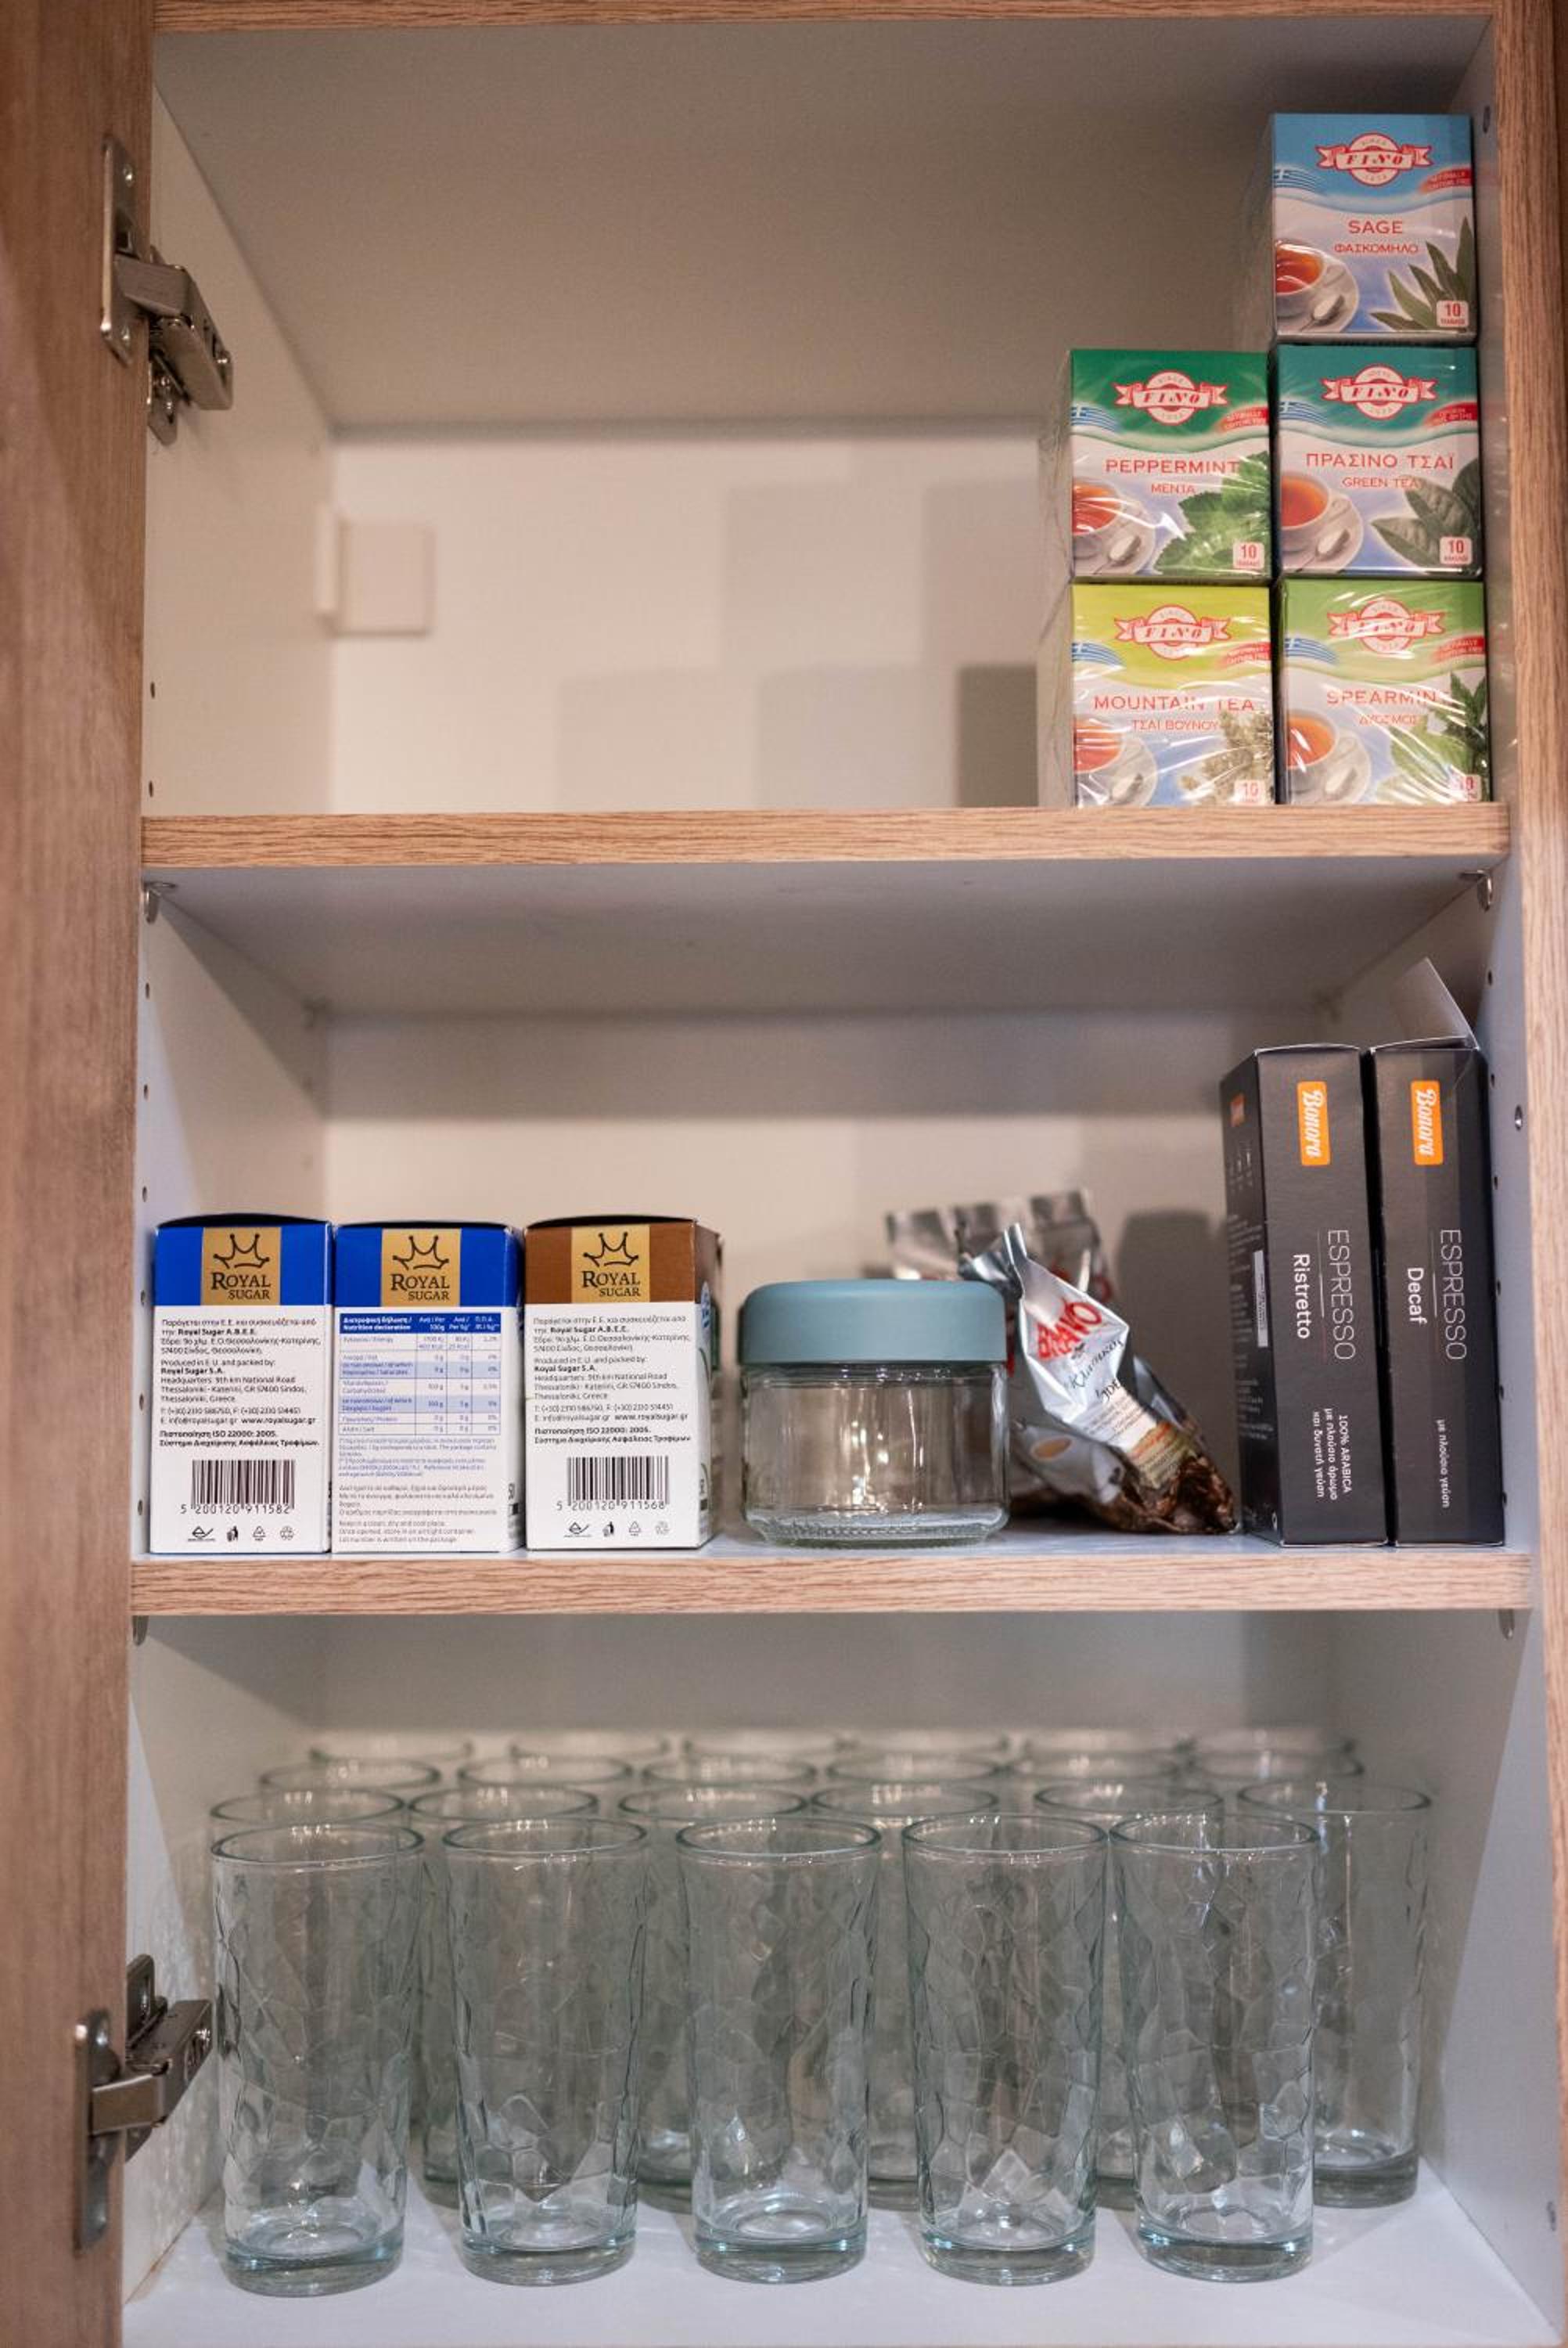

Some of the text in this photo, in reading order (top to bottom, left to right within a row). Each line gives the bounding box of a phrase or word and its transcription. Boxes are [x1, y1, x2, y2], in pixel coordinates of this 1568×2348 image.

[1346, 154, 1404, 165] FINO
[1348, 220, 1403, 234] SAGE
[1444, 303, 1461, 316] 10
[1140, 393, 1200, 404] FINO
[1351, 388, 1409, 398] FINO
[1105, 459, 1240, 474] PEPPERMINT
[1306, 453, 1397, 468] ΠΡΑΣΙΝΟ
[1342, 477, 1418, 488] GREEN TEA
[1240, 544, 1257, 559] 10
[1448, 540, 1463, 554] 10
[1145, 628, 1203, 639] FINO
[1216, 698, 1254, 711] TEA
[1301, 1090, 1325, 1158] Bonora
[1415, 1089, 1438, 1157] Bonora
[211, 1273, 271, 1290] ROYAL
[390, 1274, 450, 1291] ROYAL
[582, 1270, 640, 1288] ROYAL
[228, 1290, 270, 1300] SUGAR
[408, 1291, 450, 1301] SUGAR
[599, 1287, 640, 1297] SUGAR
[1293, 1255, 1312, 1339] Ristretto
[1328, 1230, 1356, 1360] ESPRESSO
[1407, 1267, 1427, 1325] Decaf
[1440, 1229, 1467, 1360] ESPRESSO
[178, 1328, 201, 1337] Royal
[202, 1328, 225, 1337] Sugar
[550, 1326, 573, 1335] Royal
[574, 1326, 596, 1335] Sugar
[237, 1359, 264, 1368] packed
[608, 1356, 636, 1365] packed
[160, 1367, 184, 1376] Royal
[185, 1367, 208, 1376] Sugar
[534, 1365, 556, 1374] Royal
[557, 1365, 580, 1374] Sugar
[209, 1395, 236, 1403] Greece
[614, 1413, 689, 1423] www.royalsugar.gr
[1323, 1408, 1334, 1421] με
[241, 1417, 316, 1425] www.royalsugar.gr
[1436, 1419, 1446, 1431] με
[1338, 1414, 1352, 1493] 100% ARABICA
[1440, 1477, 1451, 1508] γεύση
[180, 1504, 290, 1514] 5 200120 911582
[556, 1500, 665, 1511] 5 200120 911568
